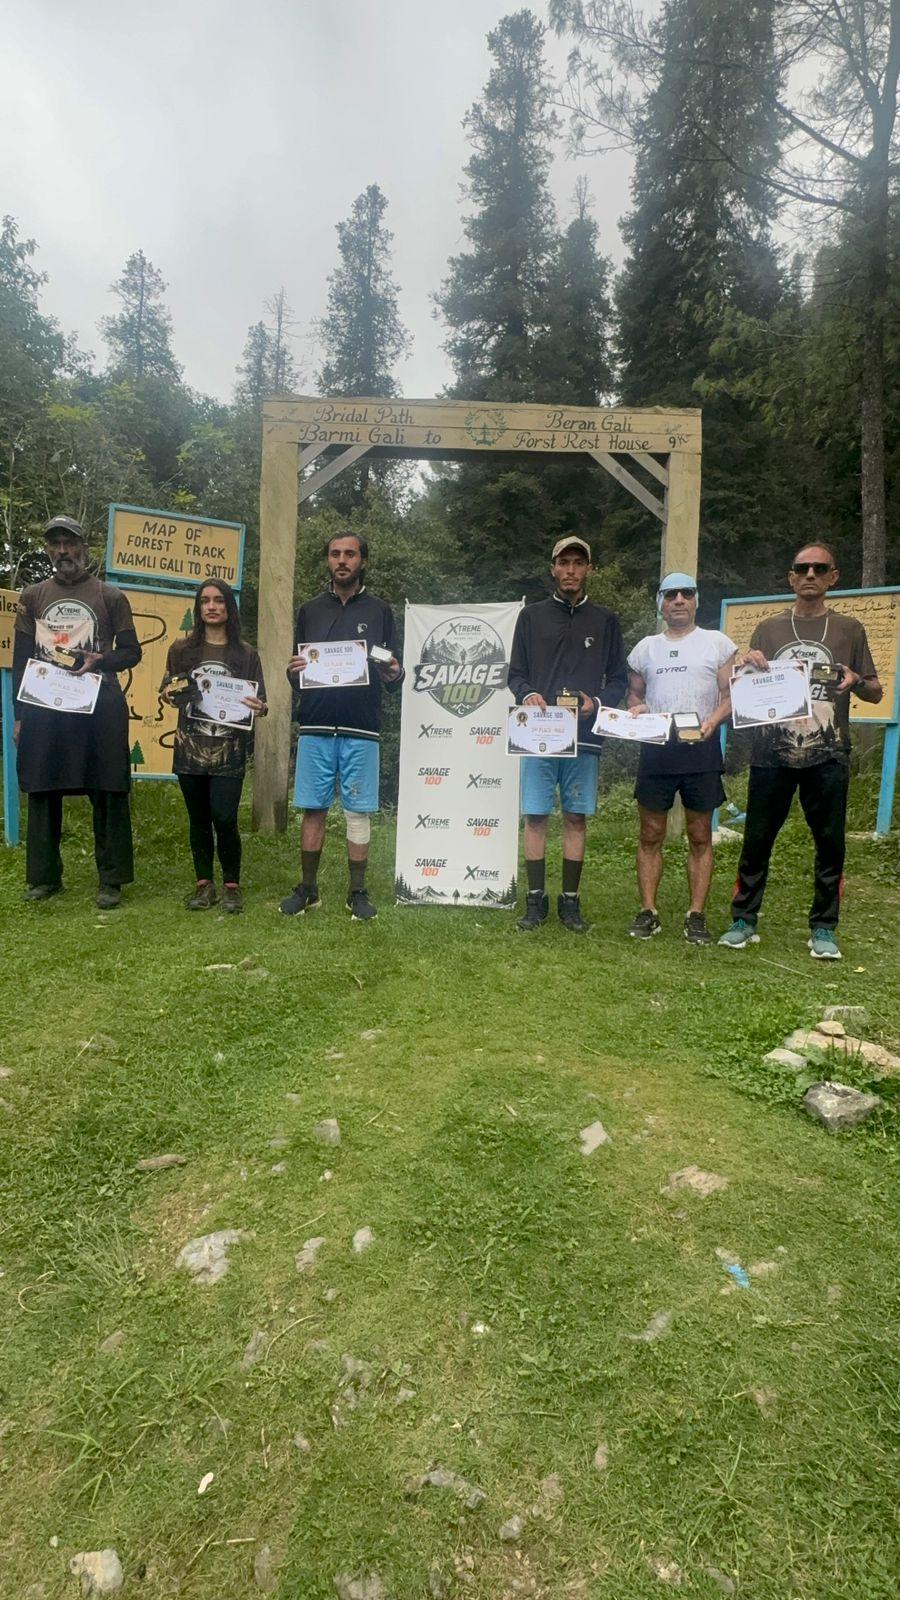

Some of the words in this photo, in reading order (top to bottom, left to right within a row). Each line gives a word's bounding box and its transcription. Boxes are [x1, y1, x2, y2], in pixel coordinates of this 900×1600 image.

[313, 404, 368, 423] Bridal
[373, 406, 415, 425] Path
[545, 410, 597, 431] Beran
[601, 415, 633, 433] Gali
[299, 424, 360, 442] Barmi
[368, 425, 405, 445] Gali
[423, 430, 441, 445] to
[513, 432, 556, 449] Forst
[564, 434, 600, 450] Rest
[608, 434, 652, 450] House
[142, 521, 177, 537] MAP
[186, 528, 202, 541] OF
[127, 535, 172, 552] FOREST
[184, 543, 225, 560] TRACK
[117, 552, 156, 568] NAMLI
[160, 557, 183, 573] GALI
[188, 561, 201, 575] TO
[205, 564, 234, 580] SATTU
[447, 622, 481, 636] XTREME
[416, 663, 505, 691] SAVAGE
[656, 666, 688, 675] GYRO
[752, 675, 773, 685] SAVAGE
[774, 673, 785, 681] 100
[442, 684, 482, 704] 100
[418, 723, 453, 739] XTREME
[469, 726, 502, 736] SAVAGE
[476, 736, 494, 745] 100
[418, 767, 450, 776] SAVAGE
[424, 776, 442, 785] 100
[466, 773, 502, 789] XTREME
[415, 813, 450, 829] XTREME
[466, 818, 499, 827] SAVAGE
[473, 827, 491, 836] 100
[415, 858, 448, 868] SAVAGE
[421, 867, 439, 876] 100
[464, 865, 500, 880] XTREME
